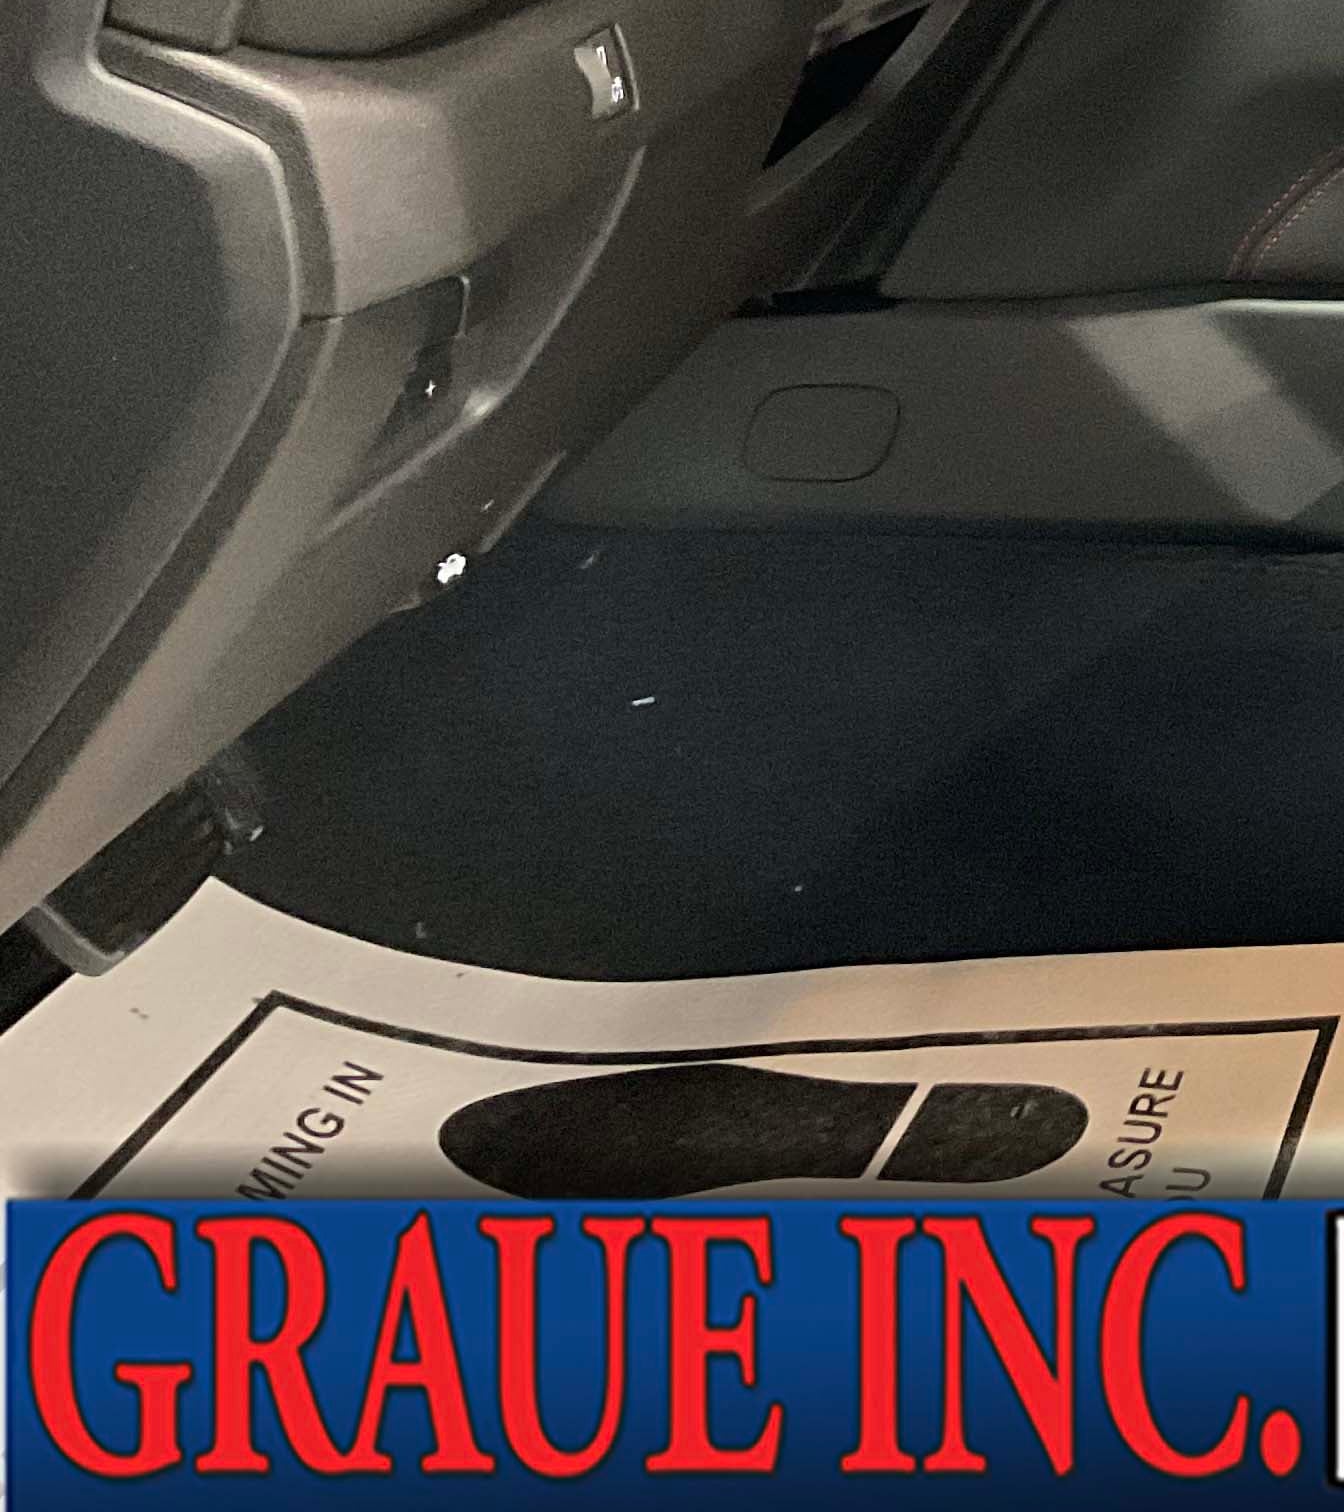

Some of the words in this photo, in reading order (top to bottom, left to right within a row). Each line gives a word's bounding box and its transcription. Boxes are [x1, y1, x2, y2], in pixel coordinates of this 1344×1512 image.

[235, 1107, 345, 1200] MING
[322, 1060, 384, 1105] IN
[1098, 1067, 1184, 1199] ASURE
